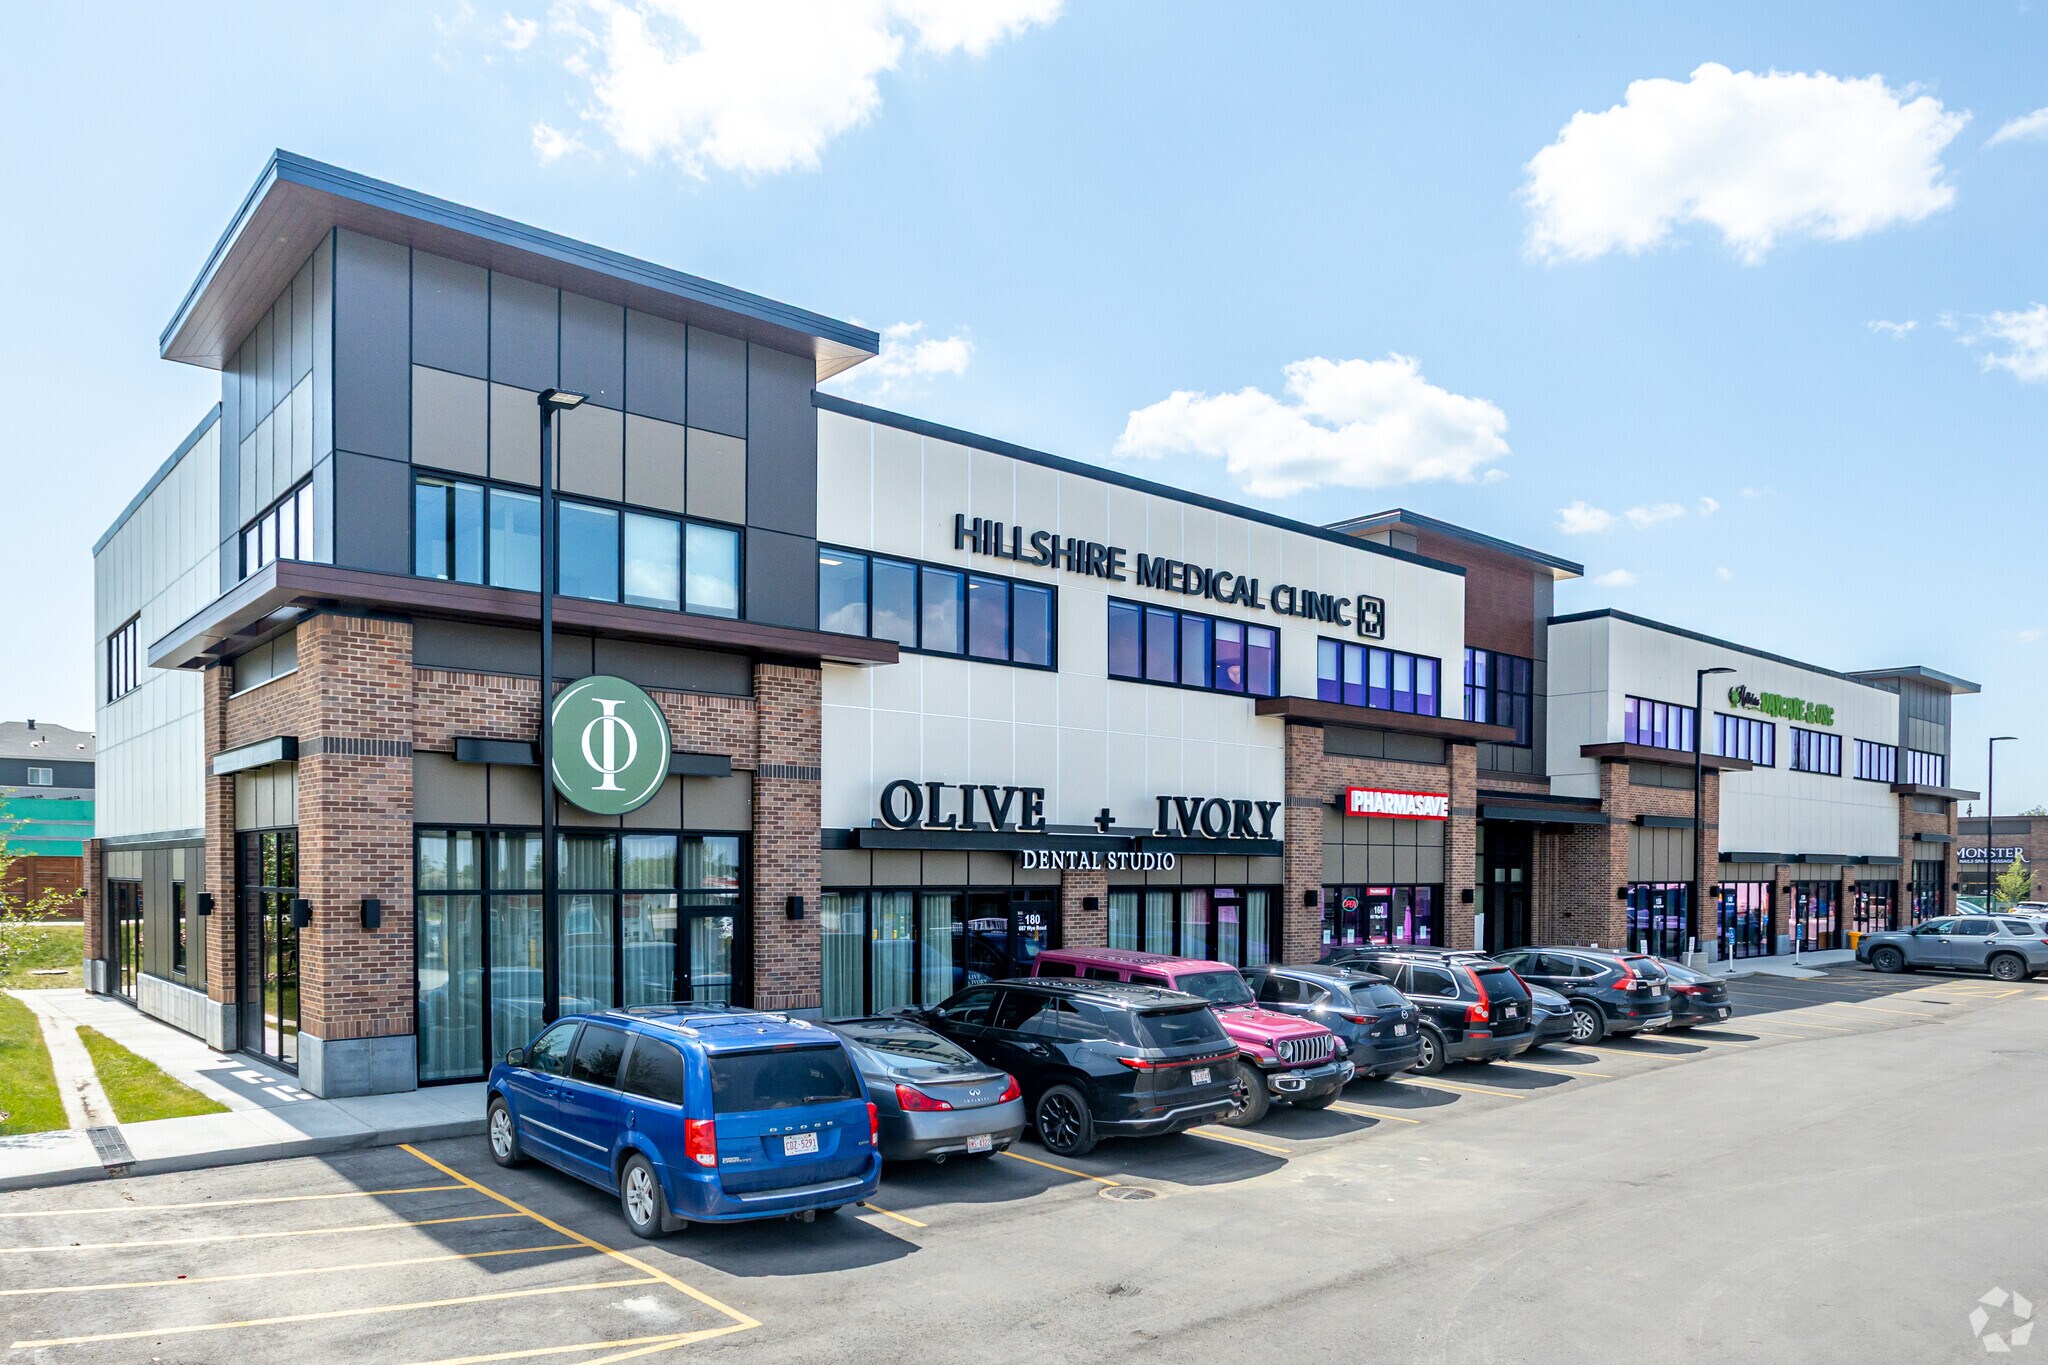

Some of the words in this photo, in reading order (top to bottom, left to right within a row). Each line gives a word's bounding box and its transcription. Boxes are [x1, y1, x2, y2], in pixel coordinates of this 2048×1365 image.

[955, 513, 1127, 582] HILLSHIRE
[1137, 553, 1266, 610] MEDICAL
[1271, 584, 1351, 626] CLINIC
[1760, 692, 1805, 721] DAYCARE
[880, 779, 1046, 832] OLIVE
[1153, 795, 1282, 840] IVORY
[1351, 790, 1449, 817] PHARMASAVE
[1023, 850, 1101, 870] DENTAL
[1107, 852, 1175, 871] STUDIO
[1956, 847, 2030, 863] MONSTER
[1343, 899, 1357, 909] OPEN
[1025, 914, 1041, 925] 180
[769, 1120, 833, 1133] DODGE
